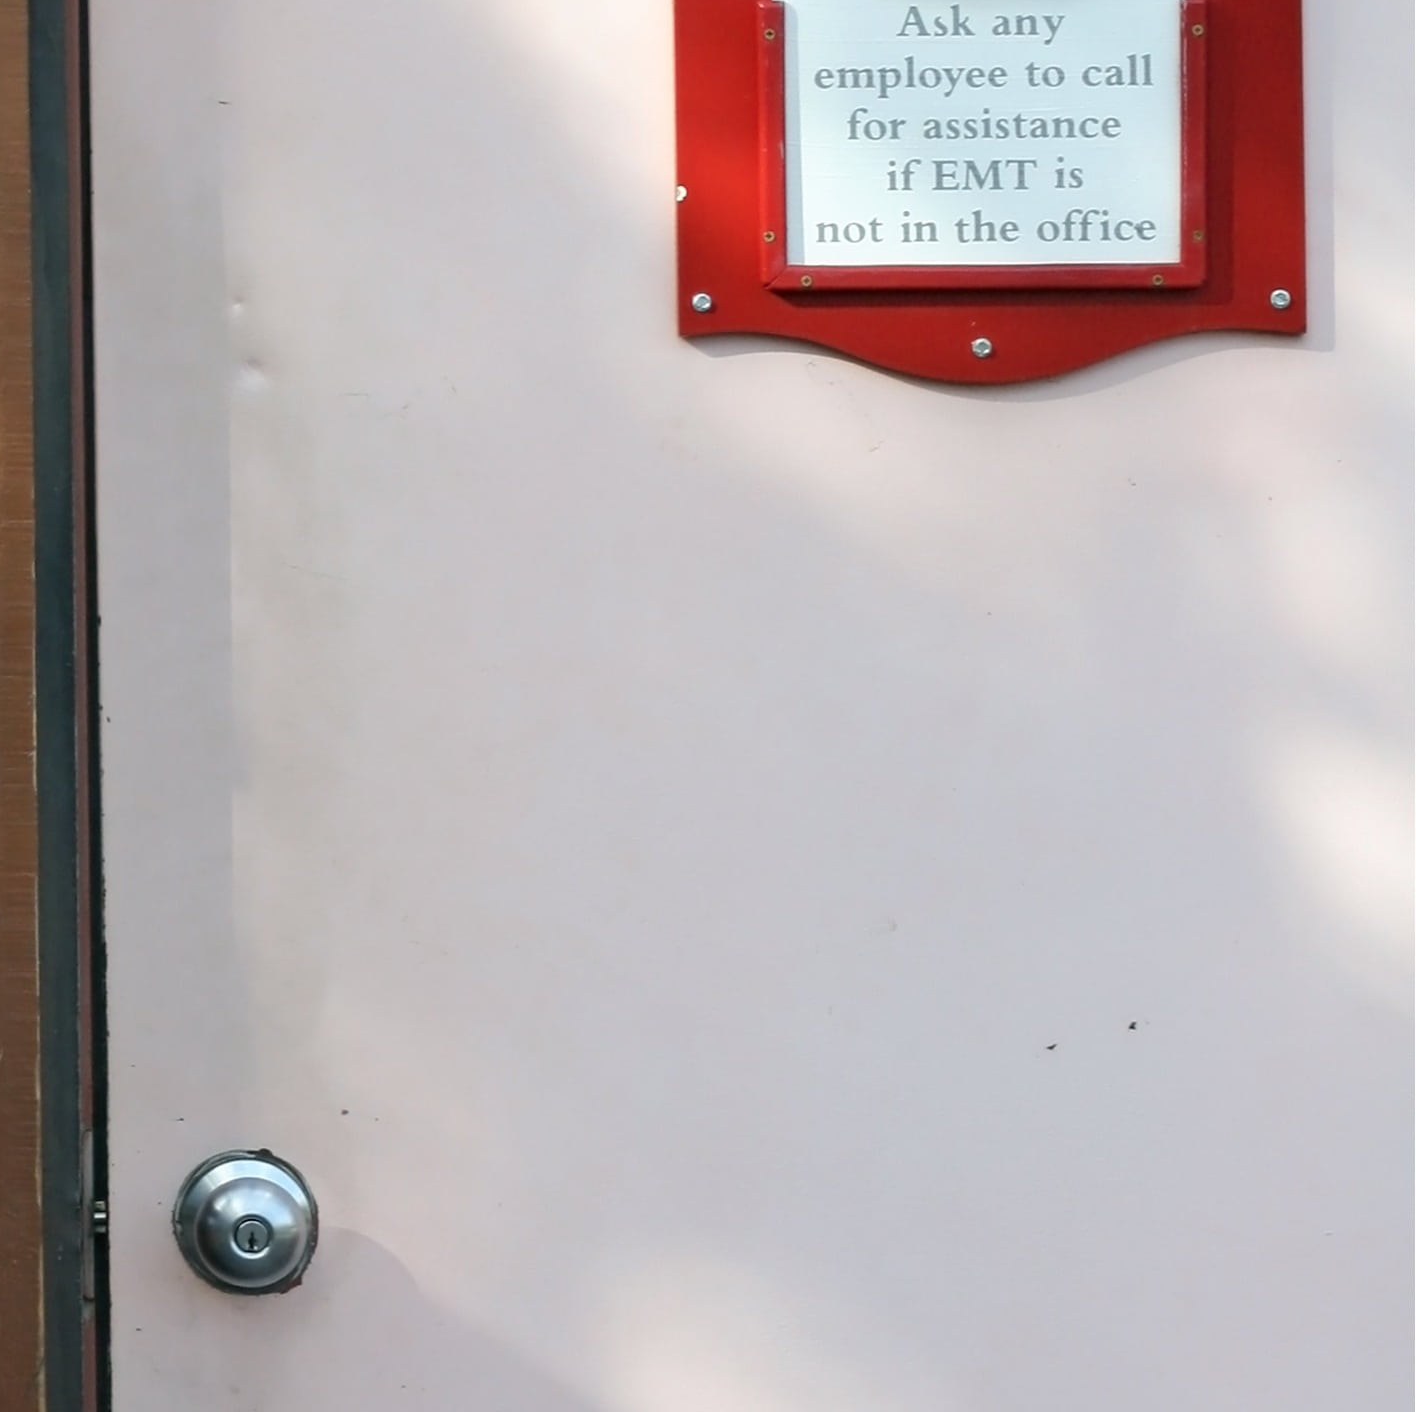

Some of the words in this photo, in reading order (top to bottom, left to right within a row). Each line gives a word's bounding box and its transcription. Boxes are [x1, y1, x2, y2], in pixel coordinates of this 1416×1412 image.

[896, 4, 976, 38] Ask
[991, 12, 1066, 45] any
[813, 56, 1009, 98] employee
[1025, 61, 1066, 88] to
[1081, 53, 1153, 87] call
[847, 107, 906, 141] for
[923, 108, 1122, 140] assistance
[886, 158, 921, 192] if
[931, 159, 1037, 191] EMT
[1054, 156, 1084, 189] is
[815, 215, 884, 244] not
[900, 210, 939, 243] in
[954, 209, 1020, 243] the
[1036, 208, 1157, 242] office
